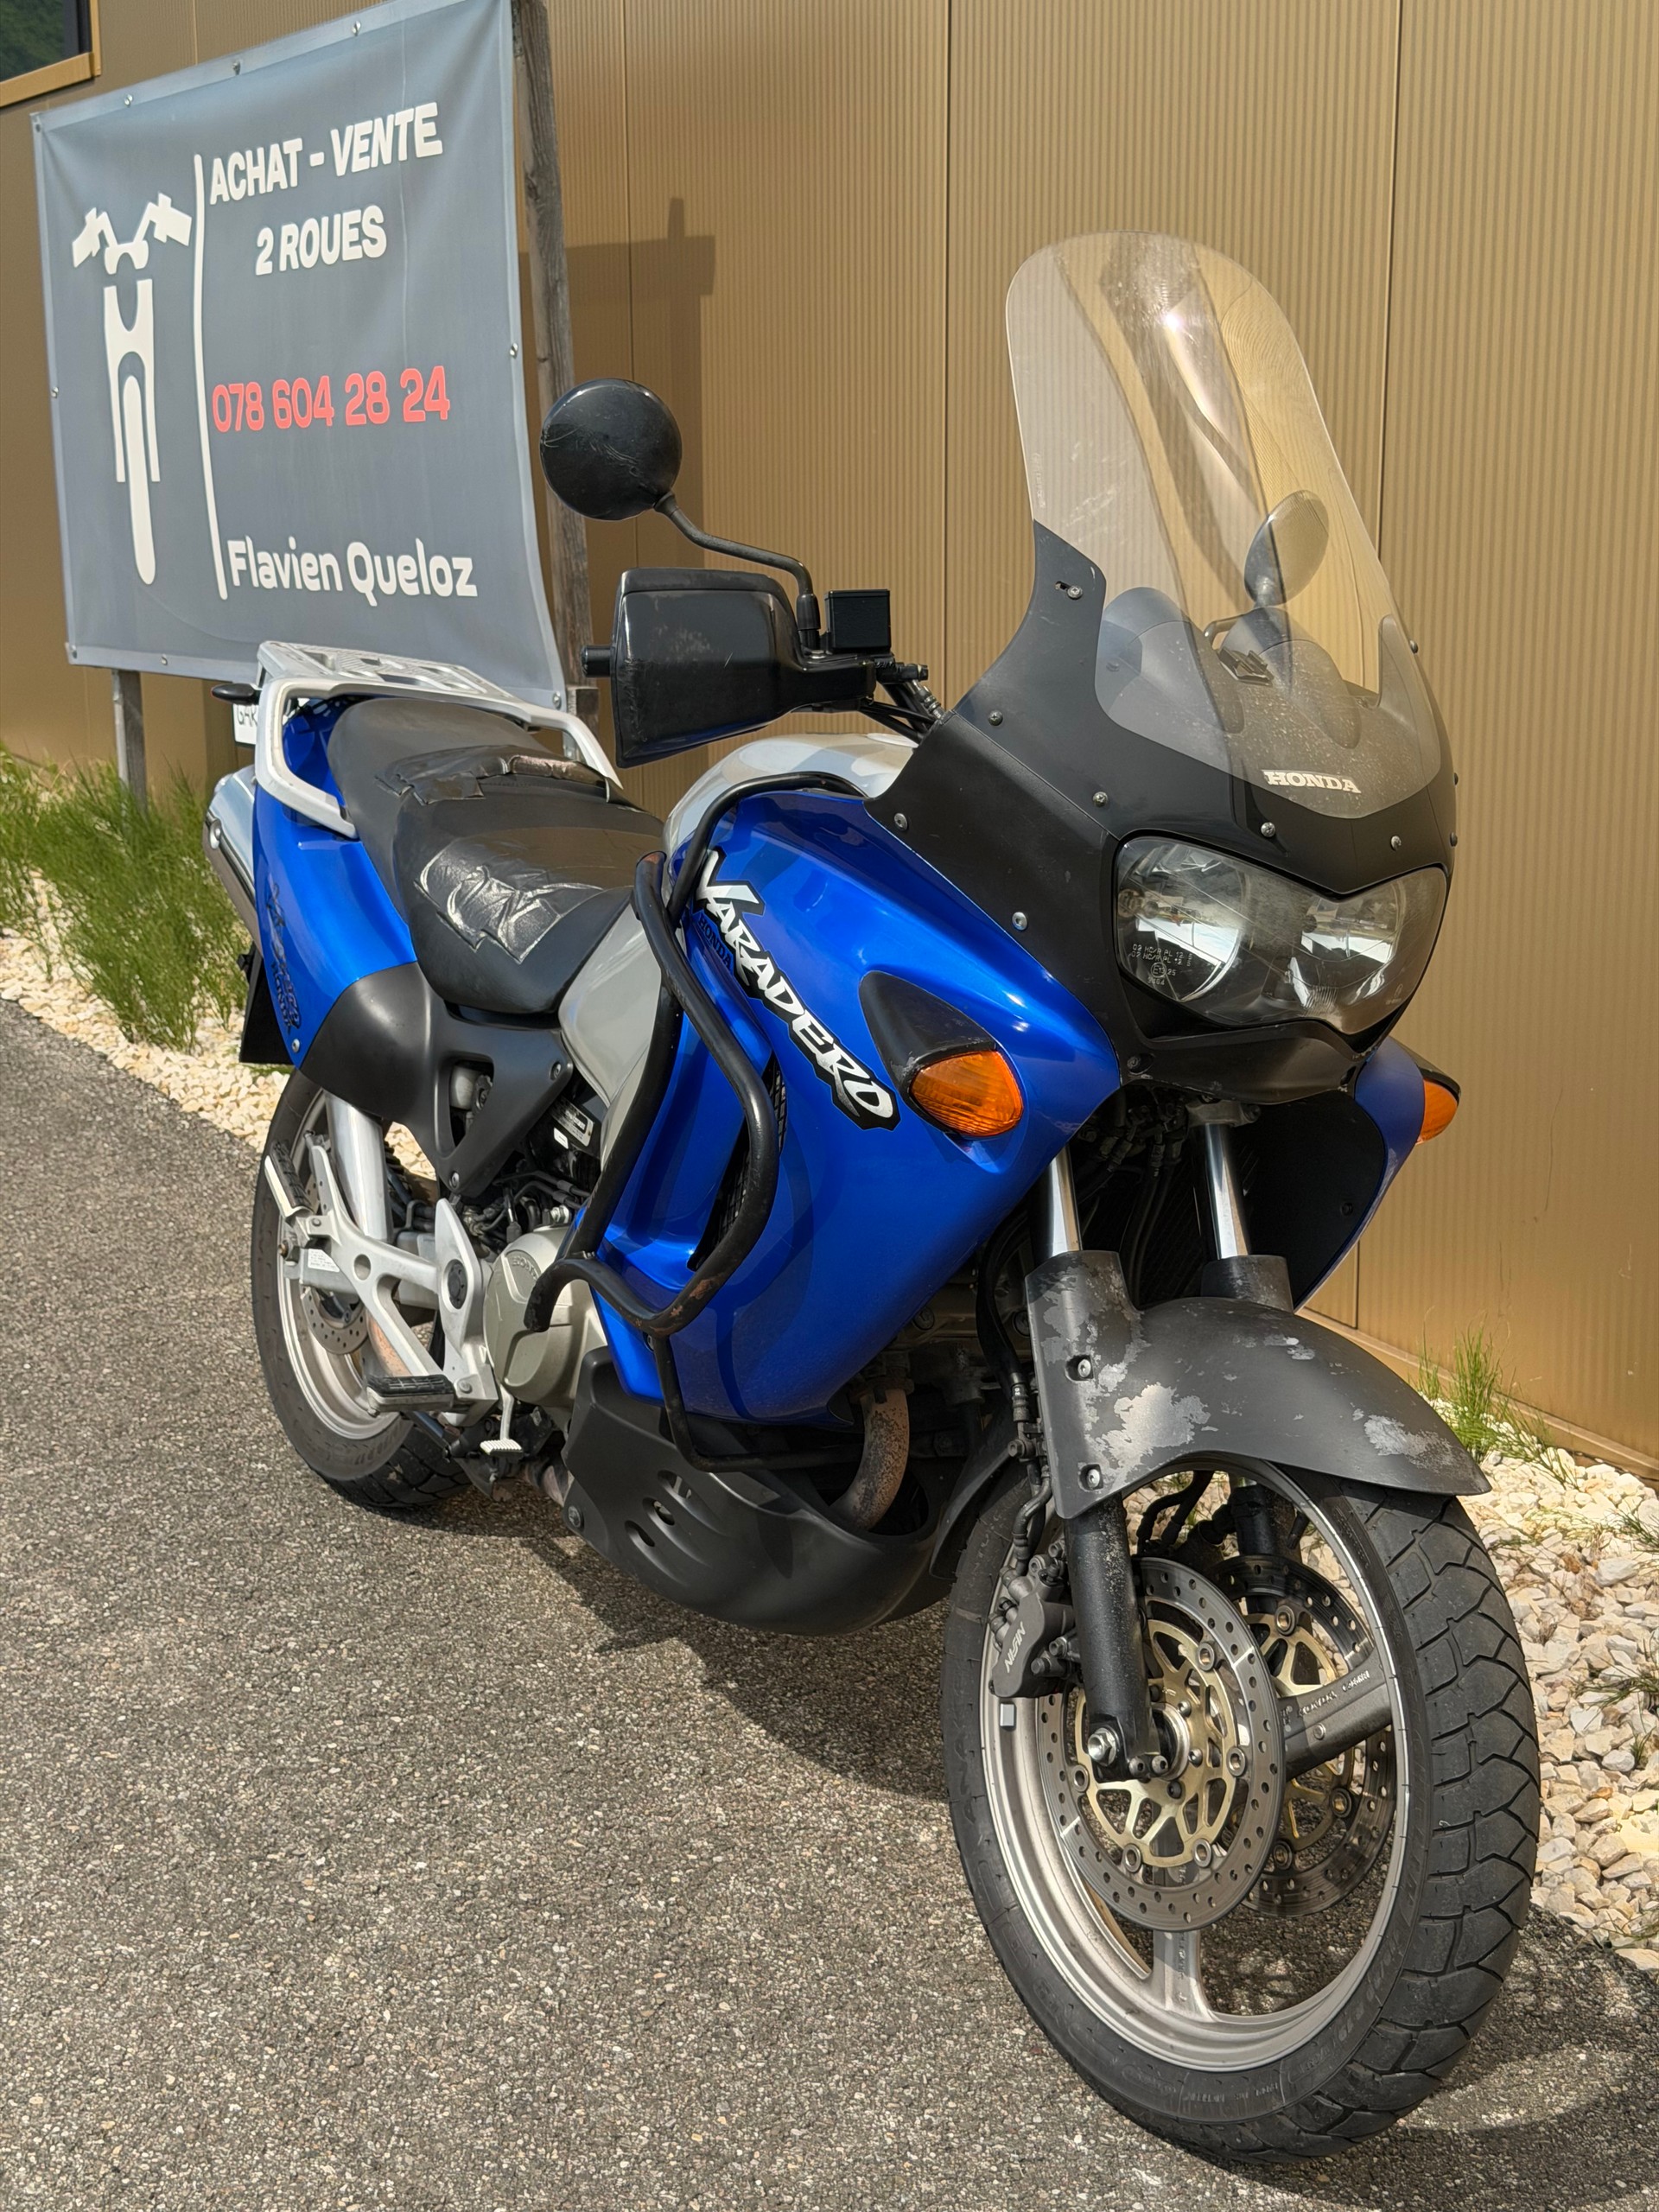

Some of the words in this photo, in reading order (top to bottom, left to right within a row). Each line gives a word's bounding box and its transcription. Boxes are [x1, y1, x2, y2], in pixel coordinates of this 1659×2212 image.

[209, 137, 303, 206] ACHAT
[308, 150, 326, 168] -
[330, 101, 443, 177] VENTE
[255, 226, 274, 276] 2
[279, 204, 387, 272] ROUES
[212, 381, 264, 433] 078
[271, 375, 334, 429] 604
[345, 371, 390, 426] 28
[399, 365, 450, 423] 24
[226, 536, 343, 592] Flavien
[346, 537, 478, 607] Queloz
[1262, 769, 1363, 795] HONDA
[696, 914, 733, 968] HONDA
[696, 849, 894, 1119] VARADERO
